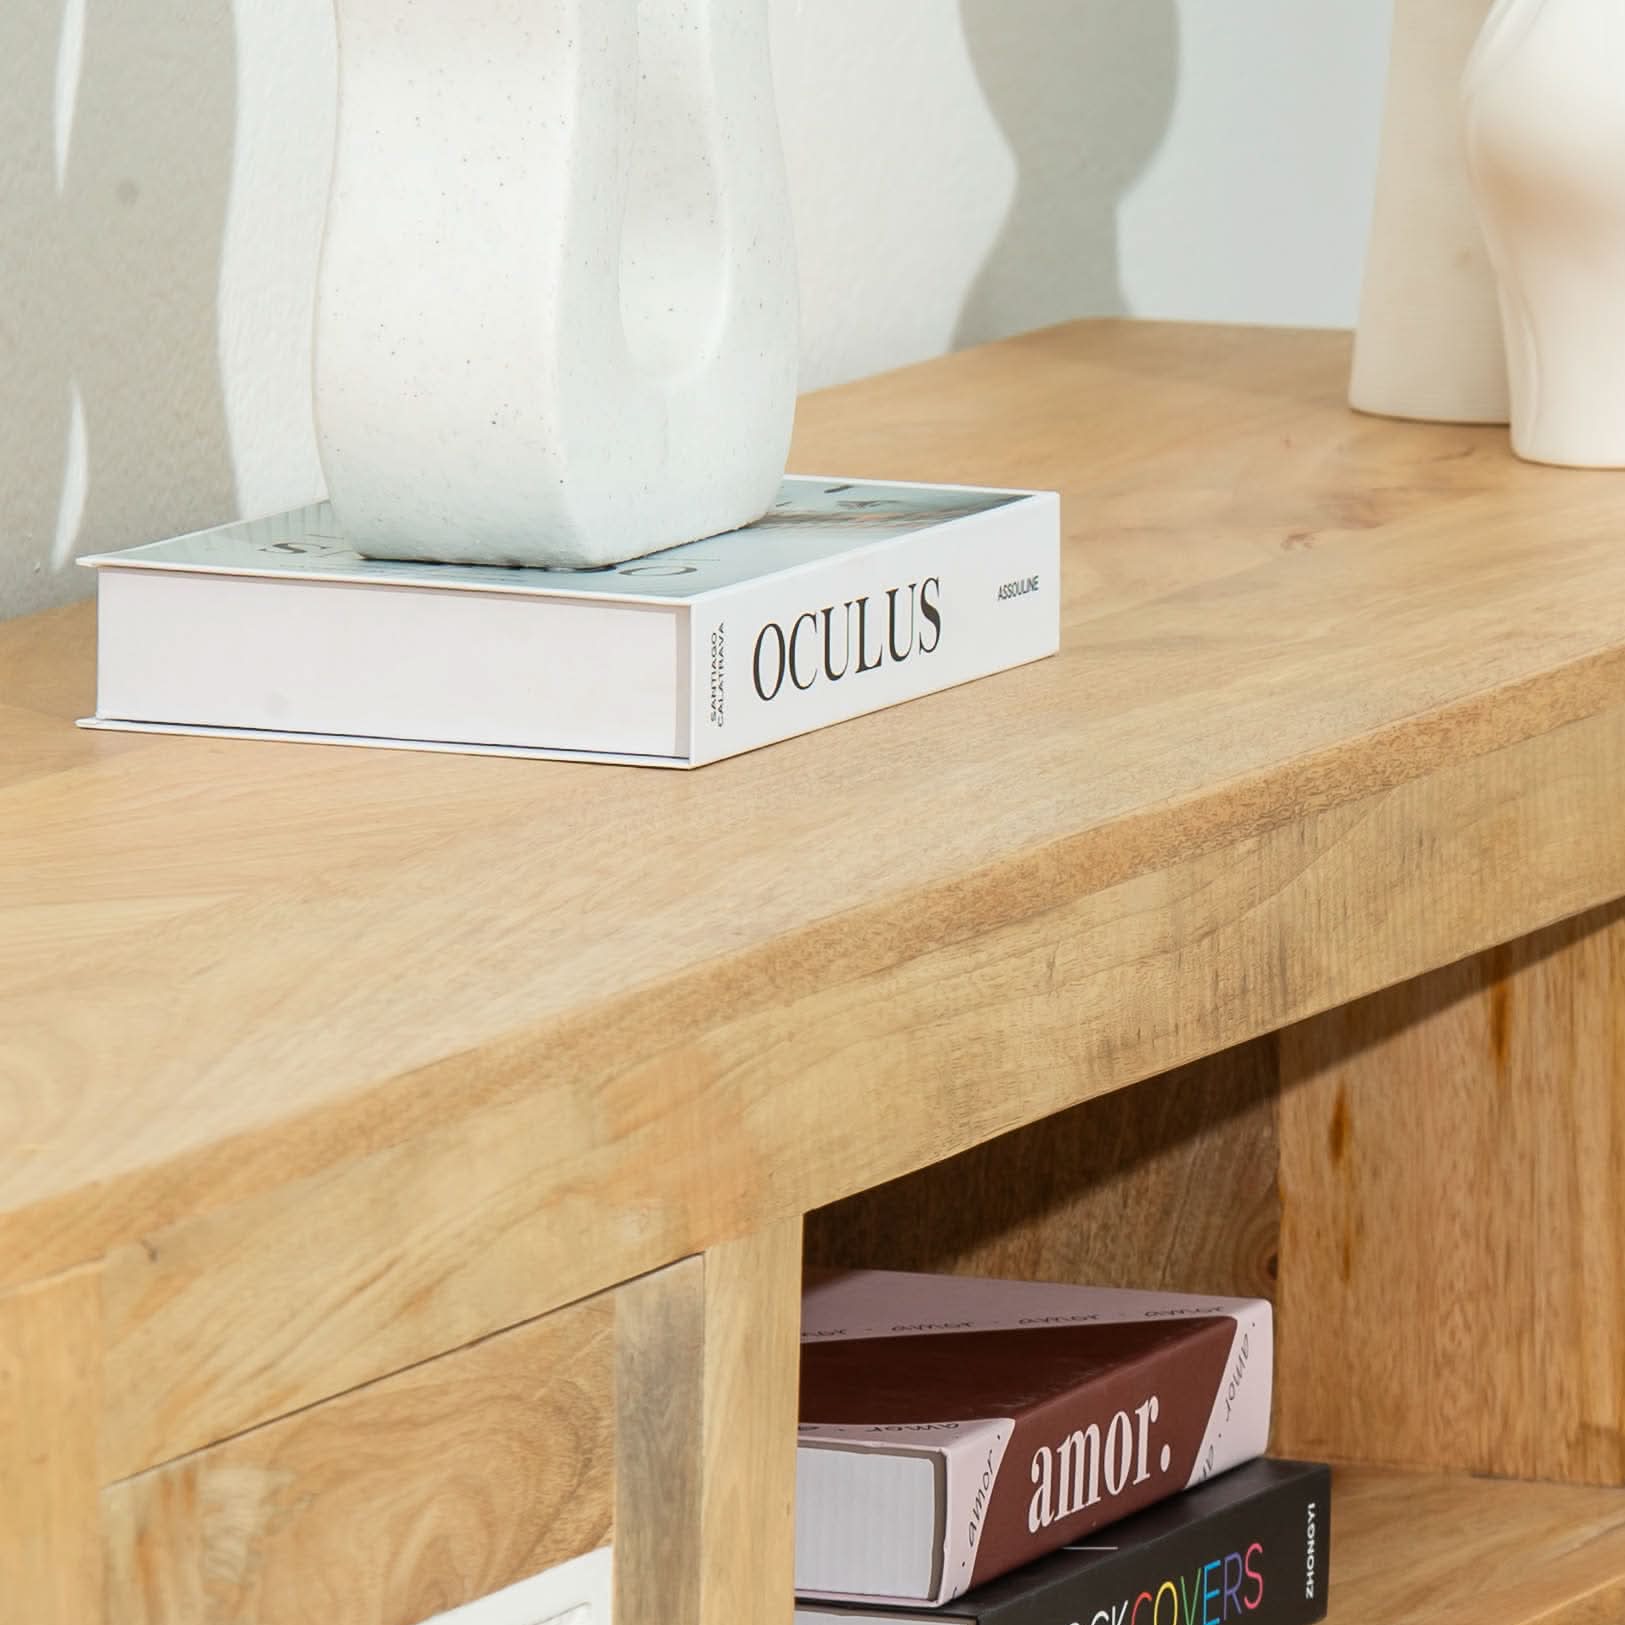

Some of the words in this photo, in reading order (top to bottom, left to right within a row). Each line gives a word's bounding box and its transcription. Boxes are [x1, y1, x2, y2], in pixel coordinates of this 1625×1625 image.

[997, 575, 1040, 602] ASSOULINE
[753, 576, 943, 702] OCULUS
[890, 1319, 976, 1333] amor
[1017, 1311, 1102, 1325] amor
[1143, 1304, 1226, 1318] amor
[1224, 1332, 1250, 1423] amor
[967, 1448, 994, 1548] amor
[1028, 1394, 1172, 1534] amor.
[1305, 1502, 1316, 1600] ZHONGYI
